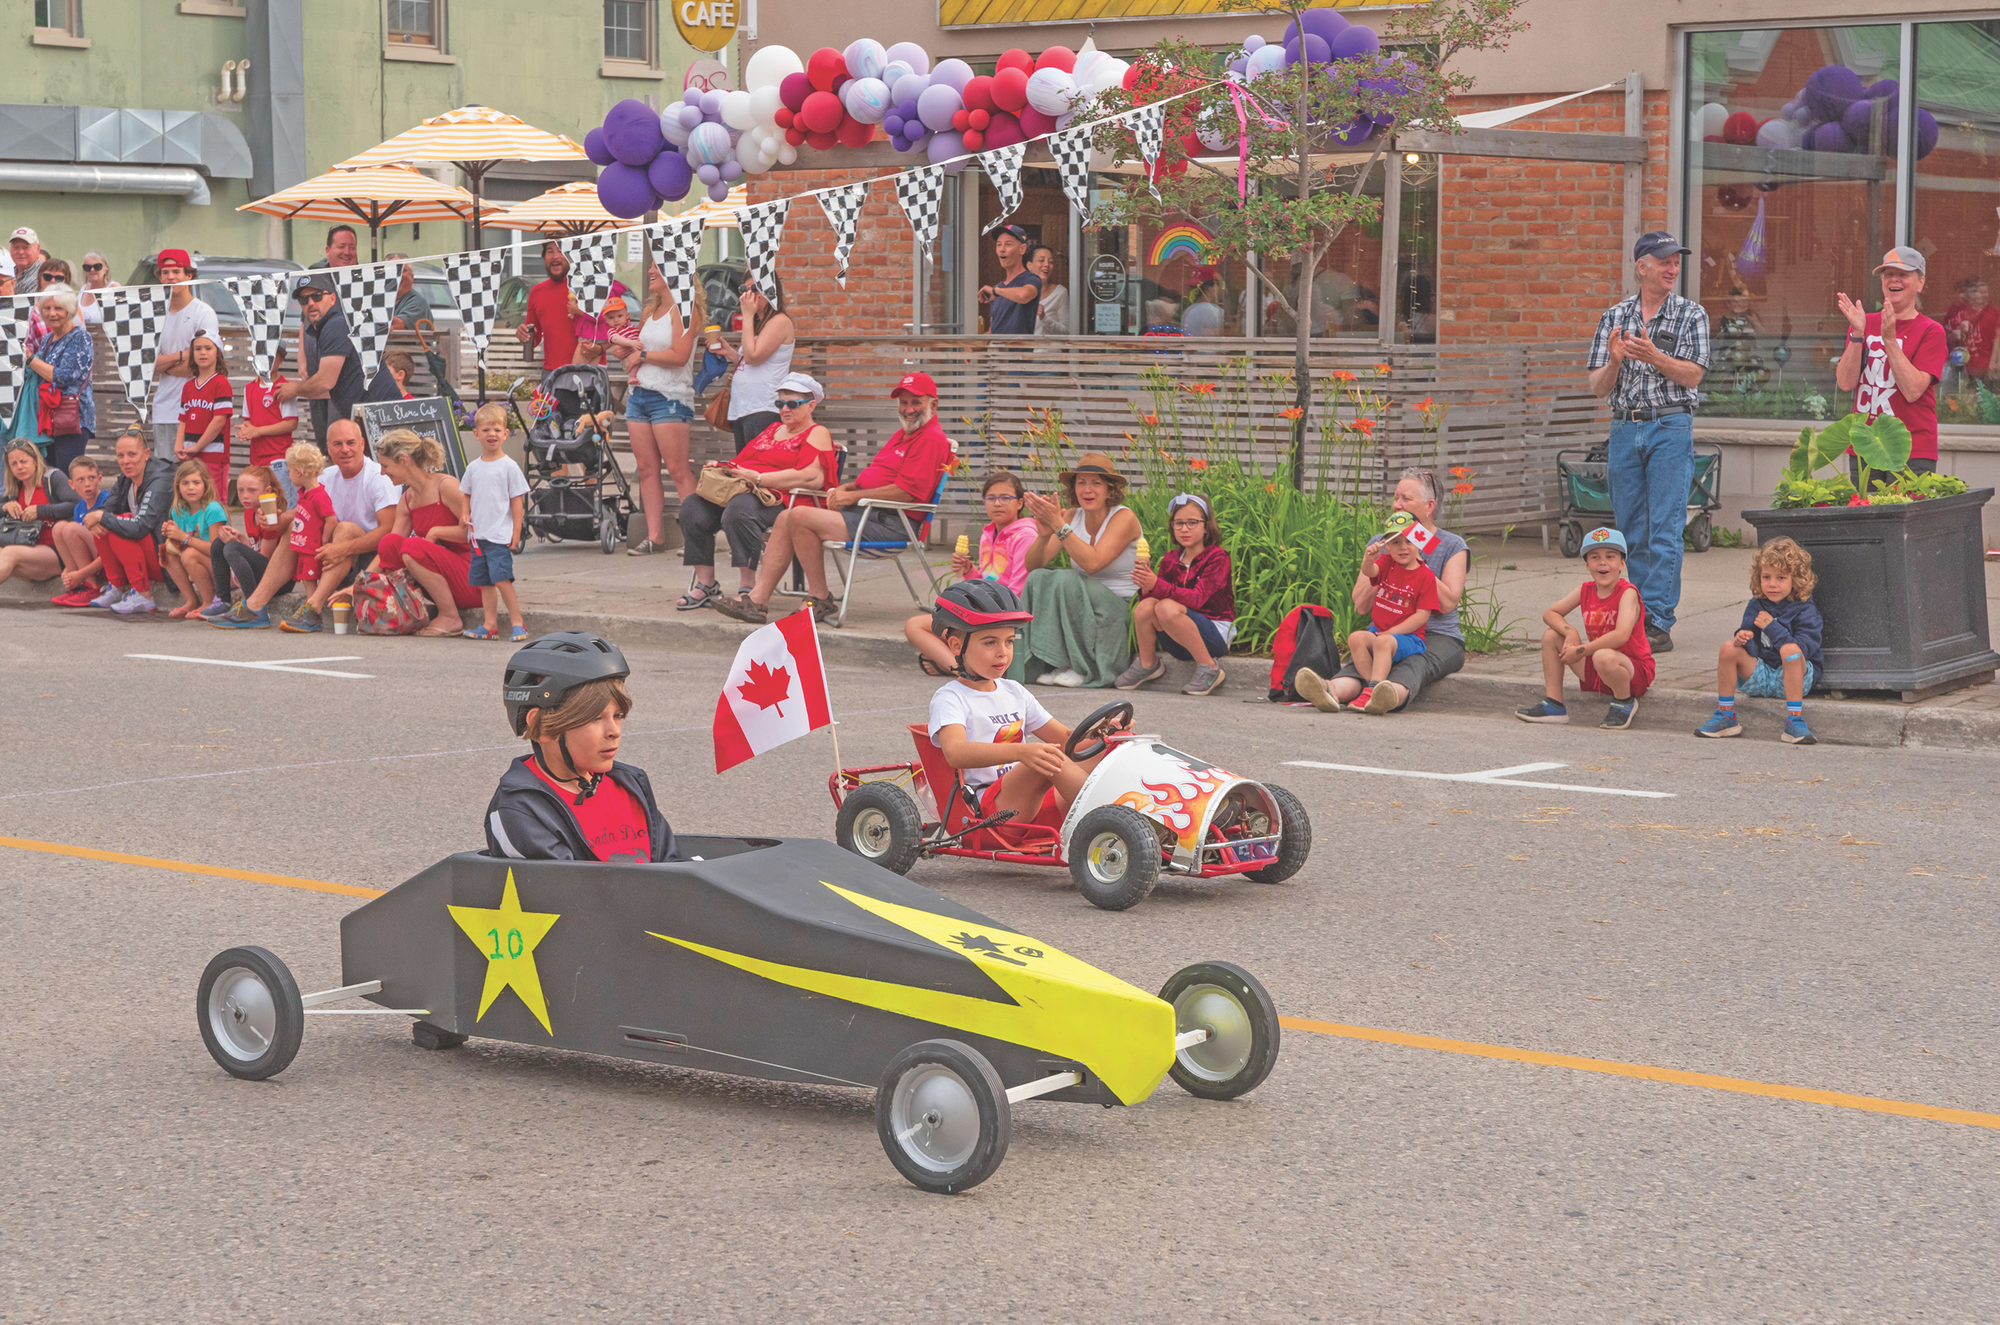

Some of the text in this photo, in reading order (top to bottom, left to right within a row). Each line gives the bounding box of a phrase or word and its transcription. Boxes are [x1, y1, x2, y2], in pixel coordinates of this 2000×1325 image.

[681, 0, 735, 27] CAFÉ
[183, 398, 213, 412] CANADA
[1857, 383, 1897, 416] CK
[374, 407, 392, 423] The
[504, 690, 531, 701] LEIGH
[988, 711, 1020, 725] BOLT
[619, 824, 648, 841] Da
[487, 927, 524, 960] 10
